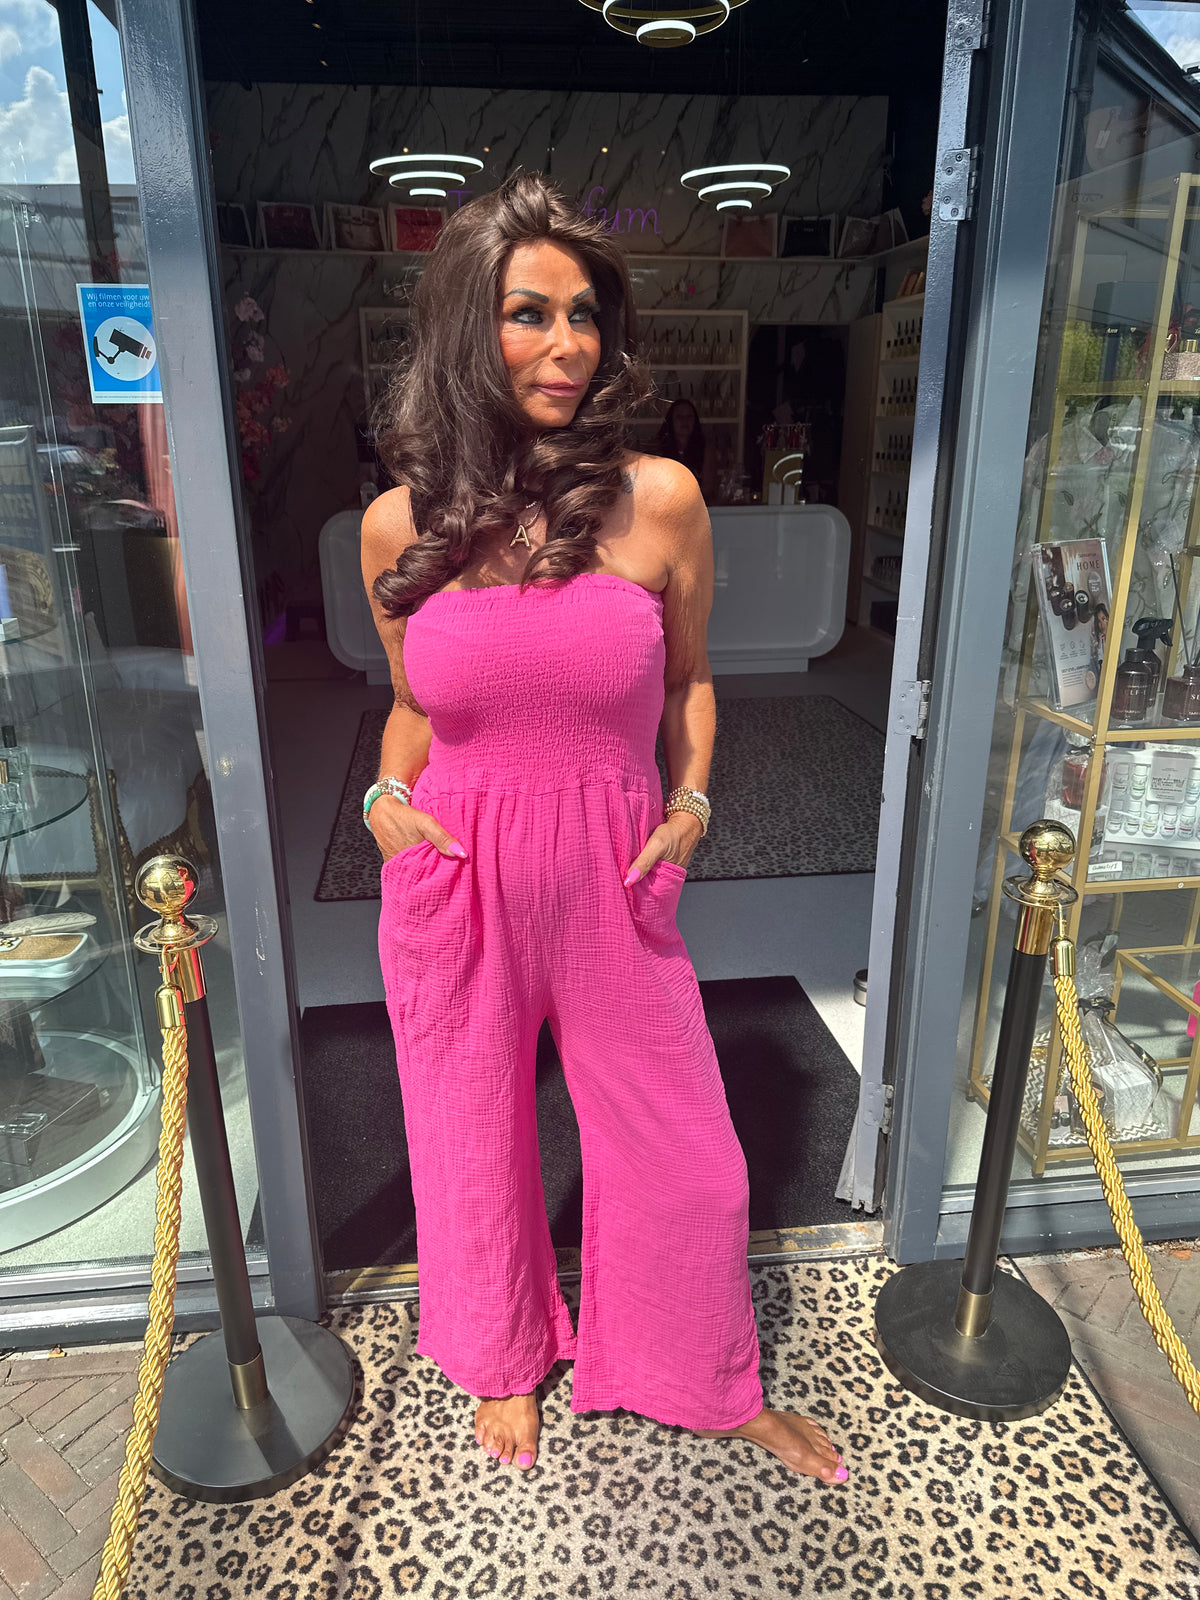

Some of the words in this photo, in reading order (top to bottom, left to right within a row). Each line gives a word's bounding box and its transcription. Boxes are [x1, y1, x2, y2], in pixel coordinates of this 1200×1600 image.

[86, 293, 99, 302] Wij
[99, 293, 122, 301] filmen
[509, 524, 530, 547] A
[1076, 560, 1100, 571] HOME
